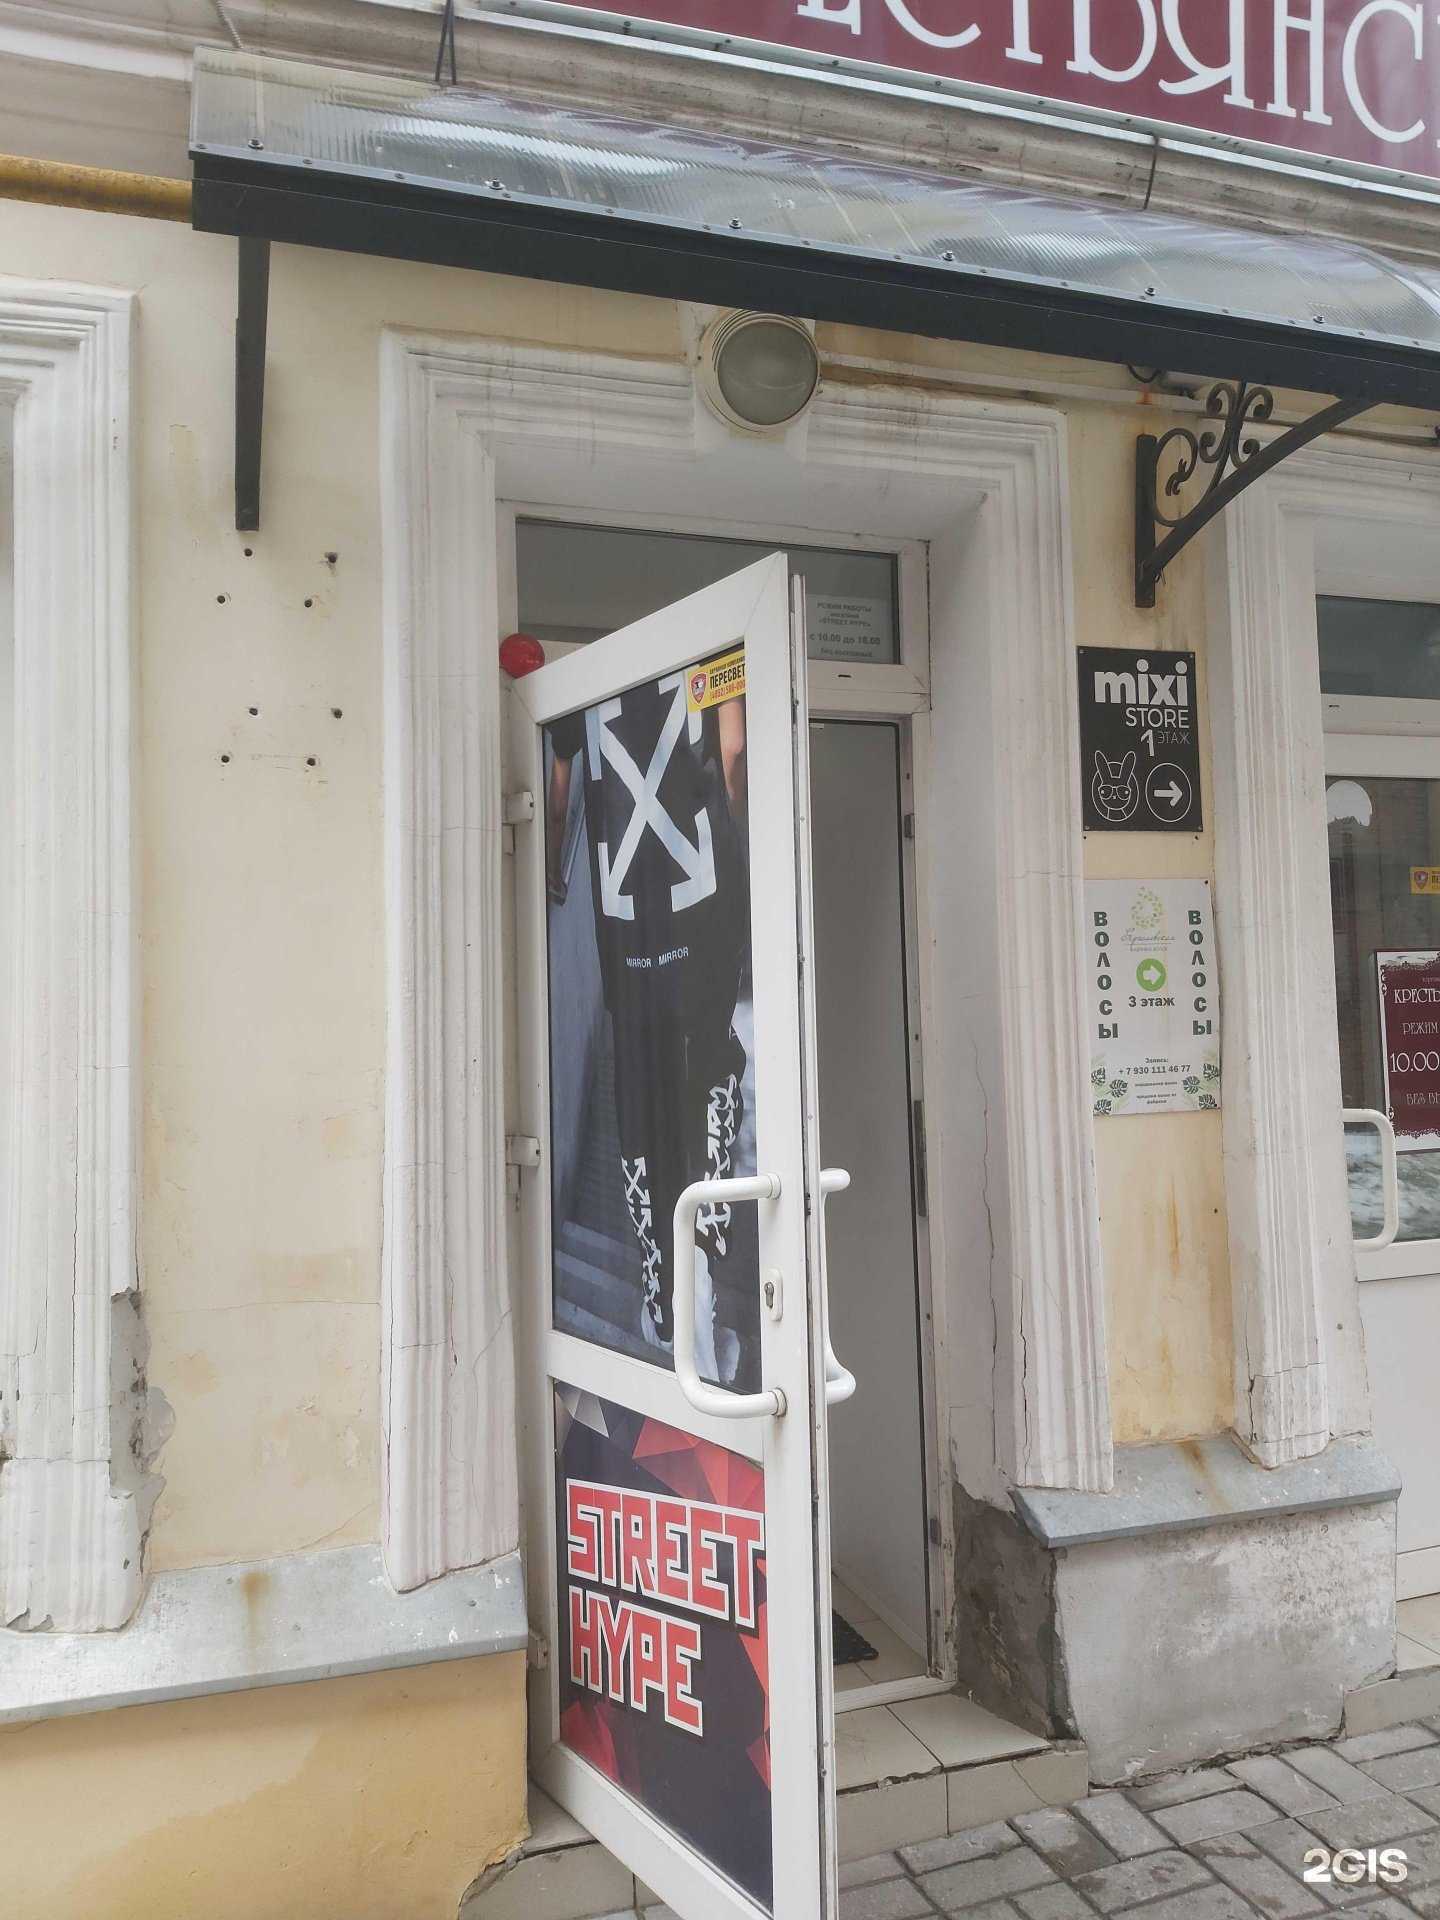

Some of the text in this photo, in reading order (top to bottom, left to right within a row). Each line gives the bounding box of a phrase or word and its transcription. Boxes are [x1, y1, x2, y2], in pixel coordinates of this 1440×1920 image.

[709, 663, 745, 690] ПЕРЕСВЕТ
[1094, 659, 1188, 706] mixi
[1125, 707, 1190, 729] STORE
[1140, 729, 1191, 757] 1 ЭТАЖ
[658, 946, 689, 966] MIRROR
[1093, 911, 1119, 1039] ВОЛОСЫ
[1187, 910, 1212, 1036] ВОЛОСЫ
[1128, 996, 1175, 1008] 3 этаж
[1402, 1022, 1439, 1036] РЕЖИМ
[1133, 1066, 1149, 1075] 930
[1181, 1064, 1191, 1072] 77
[1390, 1051, 1440, 1073] 10.00
[566, 1477, 765, 1628] STREET
[568, 1585, 703, 1737] HYPE
